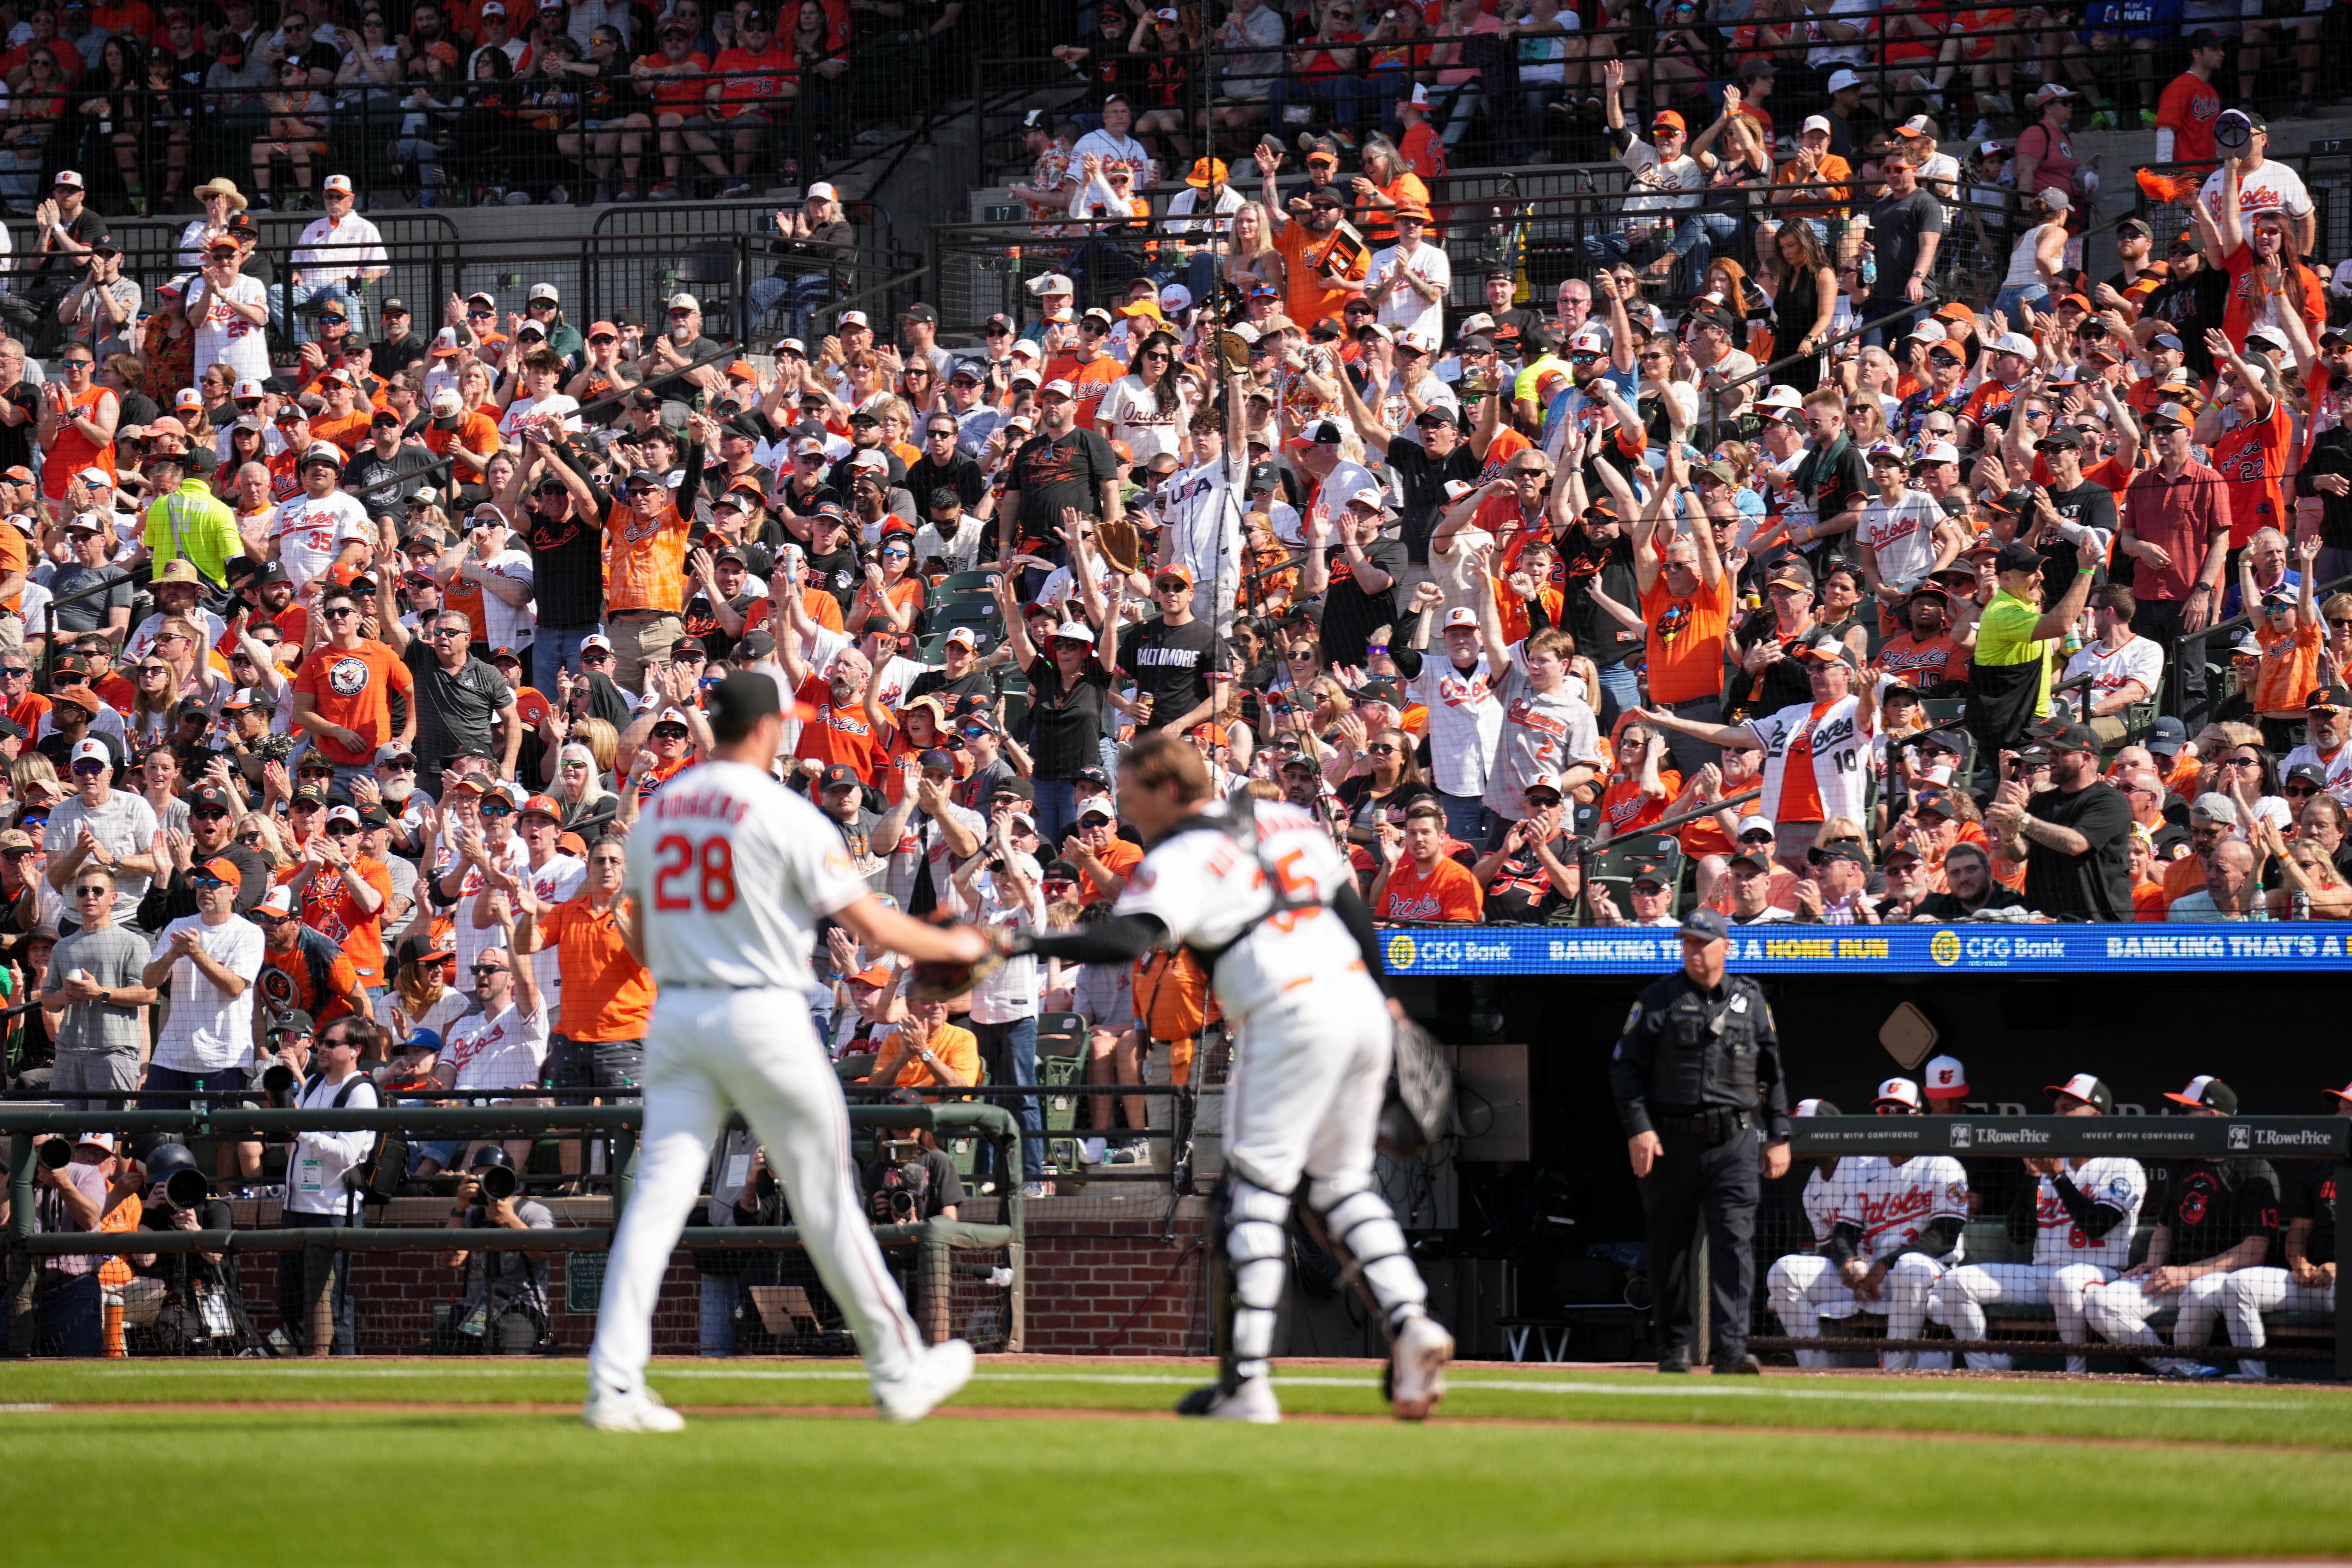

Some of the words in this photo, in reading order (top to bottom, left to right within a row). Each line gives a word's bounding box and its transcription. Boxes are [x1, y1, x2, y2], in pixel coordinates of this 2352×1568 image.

[753, 80, 774, 95] 35
[2324, 141, 2340, 151] 17
[996, 207, 1010, 220] 17
[100, 324, 110, 340] 8
[228, 322, 248, 337] 25
[2240, 457, 2265, 483] 22
[1171, 476, 1213, 505] USA
[308, 531, 332, 551] 35
[1870, 517, 1918, 545] Orioles
[268, 561, 276, 573] B
[498, 646, 508, 655] B
[1137, 648, 1200, 667] BALTIMORE
[1882, 645, 1950, 667] Orioles
[331, 659, 367, 673] BALTIMORE
[334, 682, 366, 694] ORIOLES
[1919, 669, 1942, 688] 10
[1508, 698, 1566, 733] Baltimore
[1535, 738, 1554, 762] 2
[1833, 748, 1857, 774] 10
[654, 834, 735, 911] 28
[1389, 893, 1441, 918] Orioles
[1420, 941, 1461, 961] CFG
[1465, 941, 1511, 961] Bank
[1549, 940, 1656, 960] BANKING
[1744, 939, 1763, 960] A
[1766, 939, 1834, 958] HOME
[1838, 939, 1889, 958] RUN
[1966, 938, 2010, 957] CFG
[2014, 938, 2064, 957] Bank
[2107, 937, 2224, 957] BANKING
[2228, 936, 2317, 957] THAT'S
[2321, 936, 2342, 957] A
[2140, 1132, 2194, 1140] CONFIDENCE
[1857, 1184, 1932, 1218] Orioles
[2260, 1208, 2279, 1228] 13
